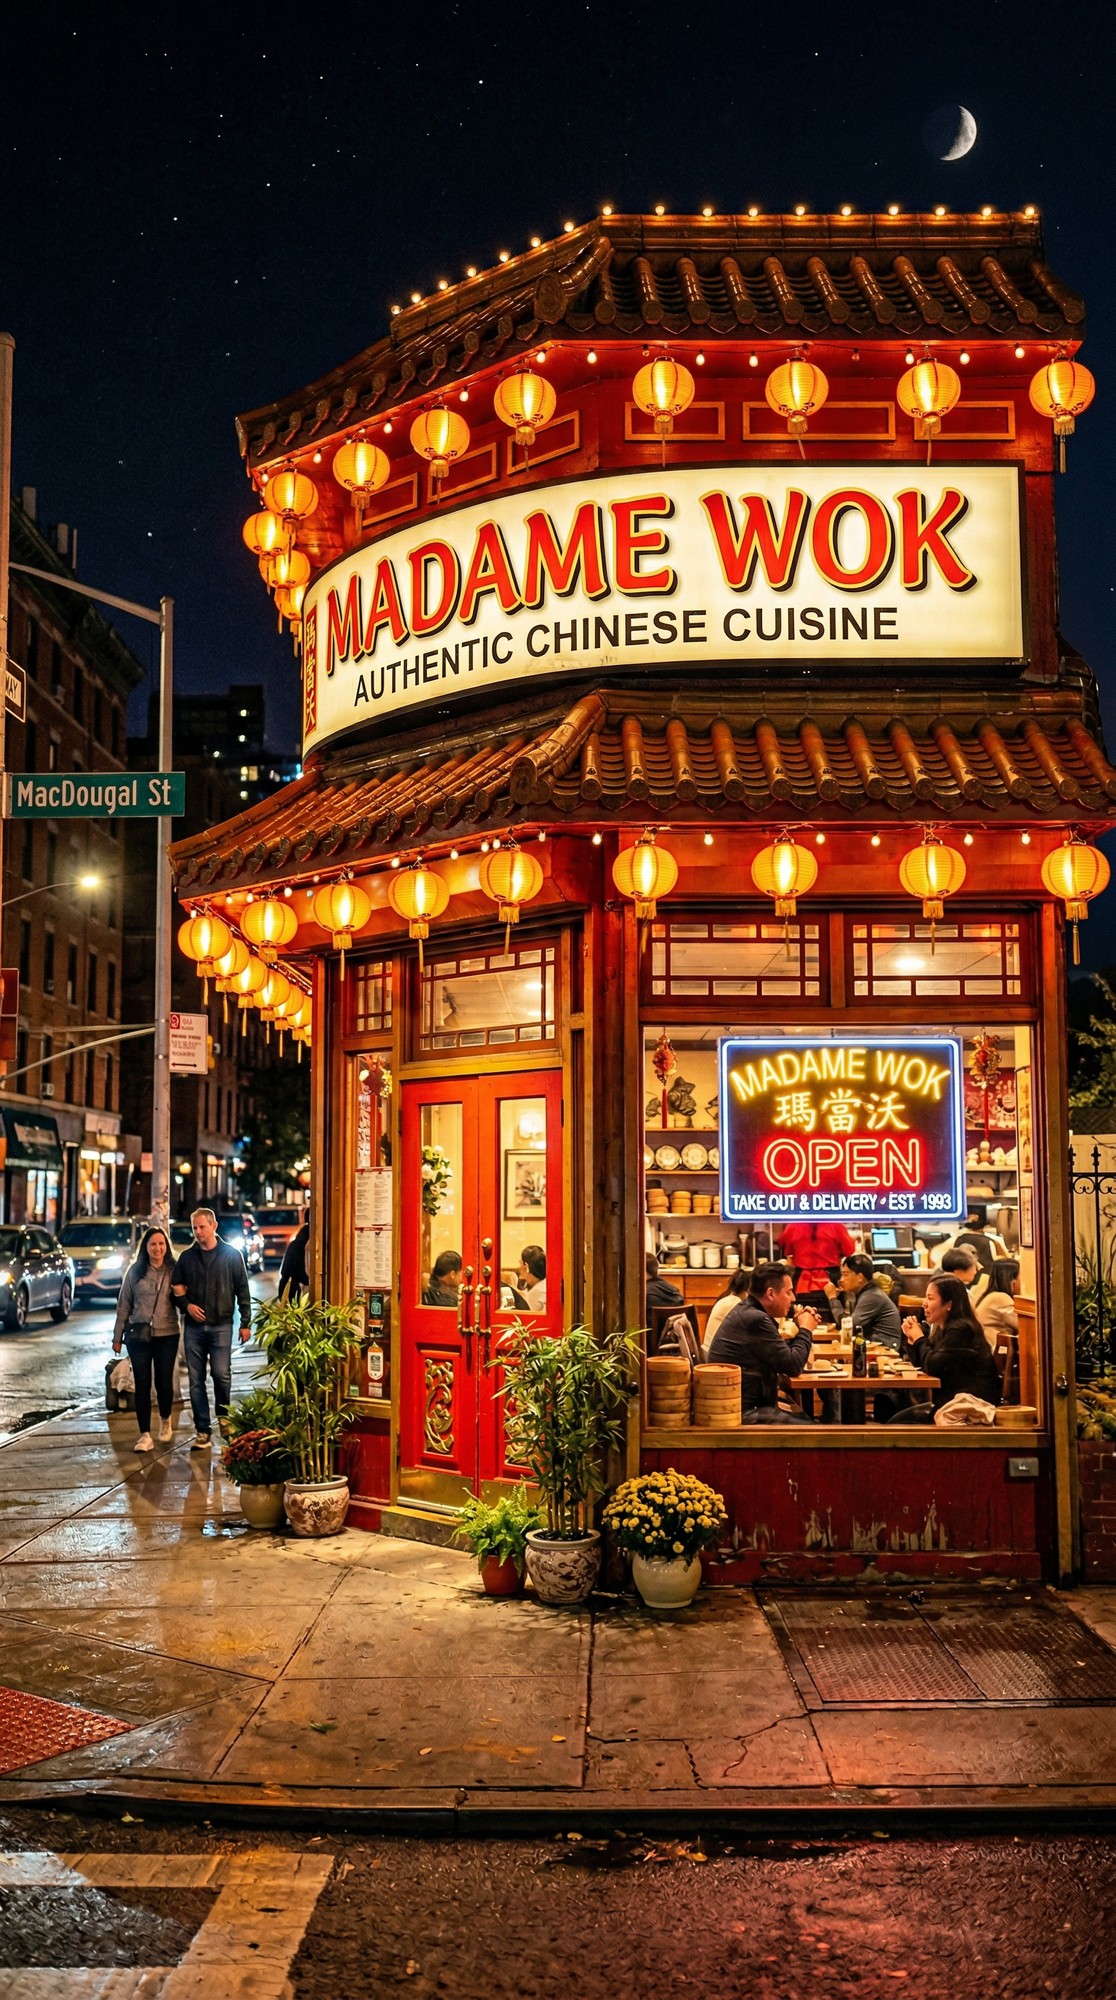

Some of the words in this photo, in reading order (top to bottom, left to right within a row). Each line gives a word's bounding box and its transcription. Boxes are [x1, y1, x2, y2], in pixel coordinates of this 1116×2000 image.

[324, 492, 678, 677] MADAME
[699, 486, 978, 592] WOK
[354, 631, 513, 707] AUTHENTIC
[526, 609, 708, 658] CHINESE
[723, 607, 899, 641] CUISINE
[17, 779, 138, 815] MacDougal
[148, 778, 172, 806] St
[729, 1048, 867, 1101] MADAME
[876, 1050, 952, 1100] WOK
[773, 1088, 911, 1133] 瑪當沃
[763, 1138, 920, 1188] OPEN
[731, 1194, 766, 1211] TAKE
[769, 1194, 797, 1211] OUT
[799, 1194, 810, 1211] &
[812, 1194, 878, 1211] DELIVERY
[888, 1193, 917, 1210] EST
[920, 1193, 952, 1210] 1993
